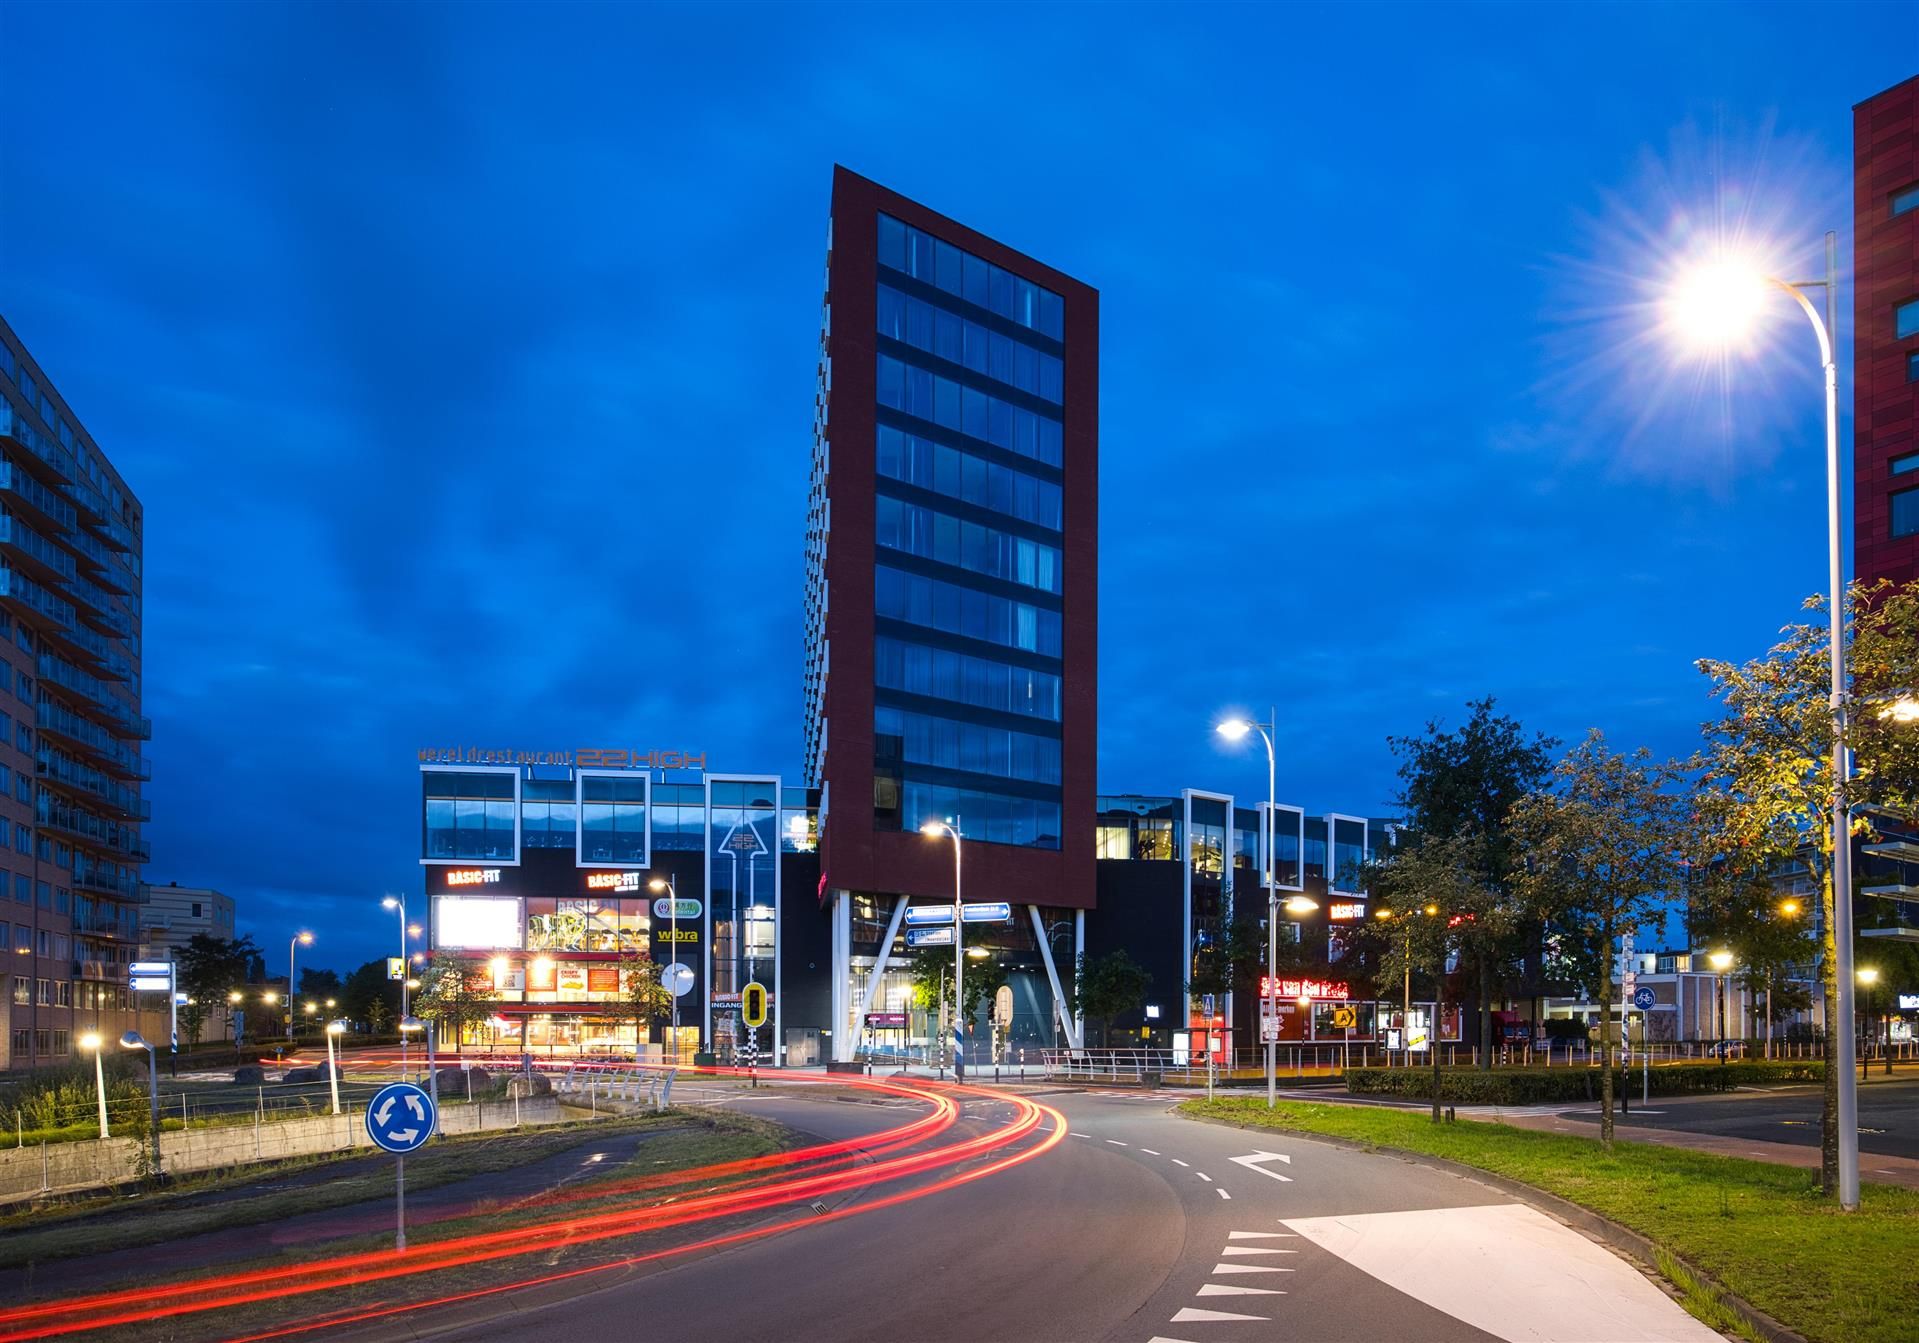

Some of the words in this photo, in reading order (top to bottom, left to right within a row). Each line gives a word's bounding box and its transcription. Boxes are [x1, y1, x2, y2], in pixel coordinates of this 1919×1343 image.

[576, 749, 628, 767] 22
[631, 750, 706, 768] HIGH
[448, 869, 500, 884] BASIC-FIT
[588, 873, 639, 888] BASIC-FIT
[1331, 904, 1364, 919] BASIC-FIT
[658, 928, 698, 940] wbra
